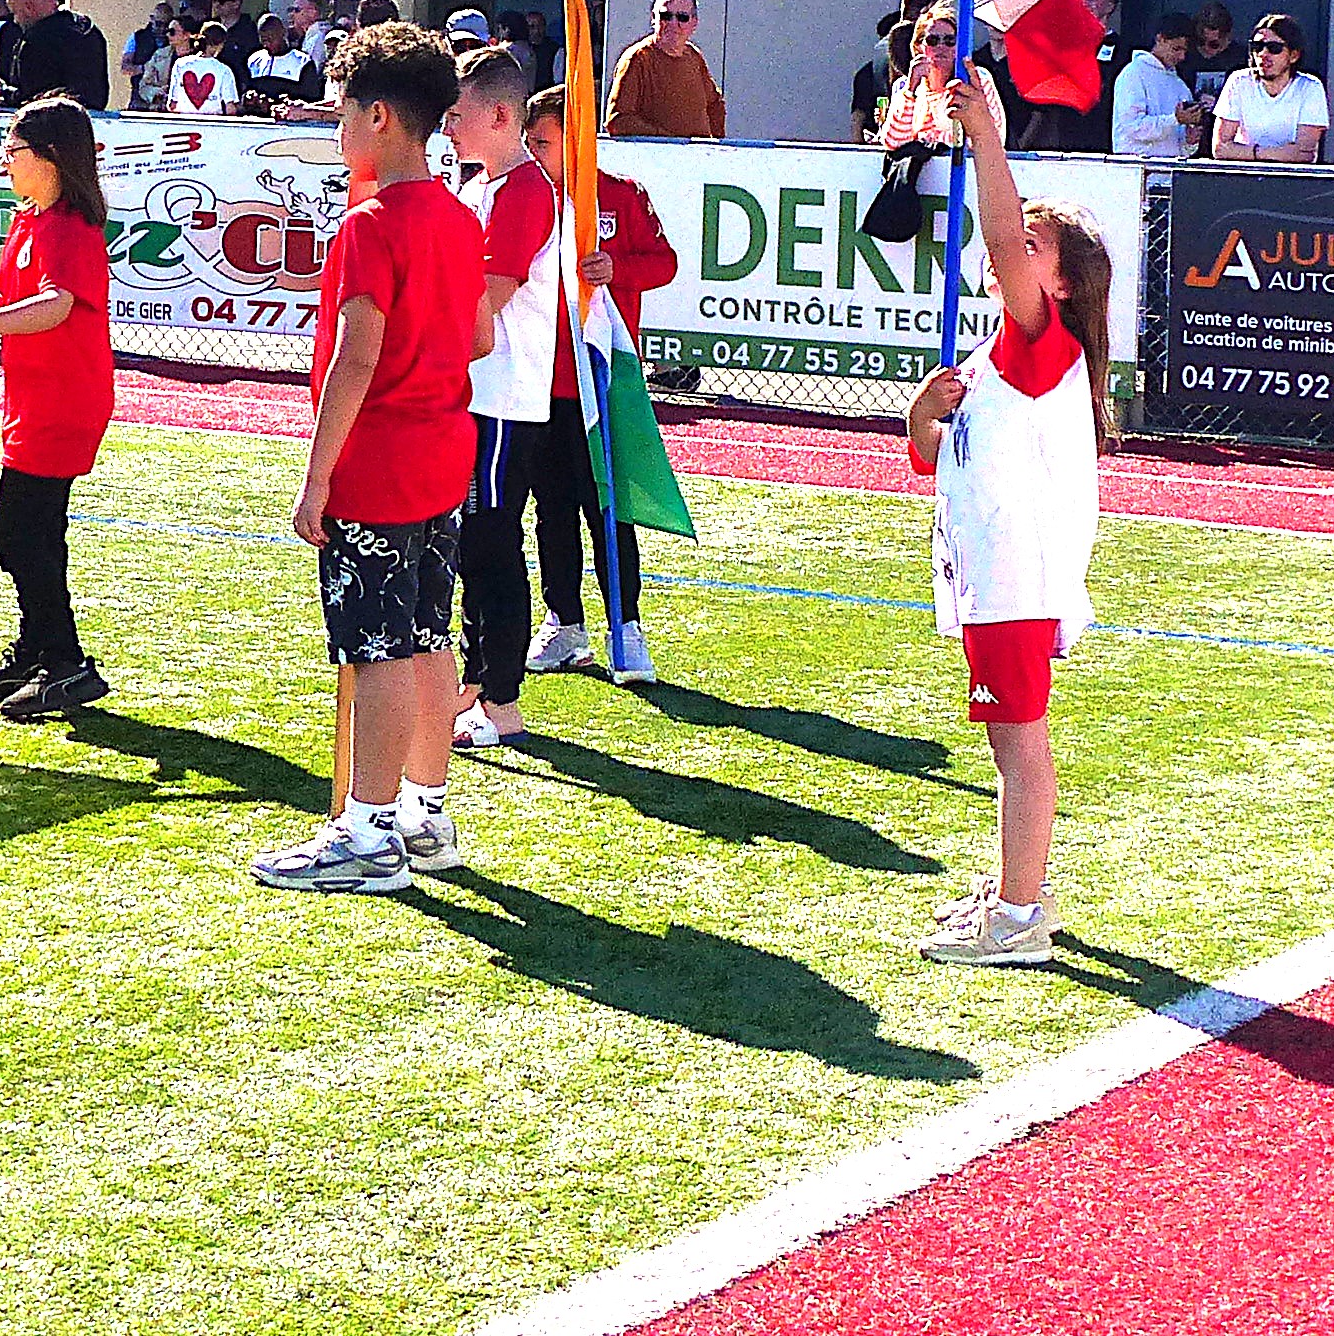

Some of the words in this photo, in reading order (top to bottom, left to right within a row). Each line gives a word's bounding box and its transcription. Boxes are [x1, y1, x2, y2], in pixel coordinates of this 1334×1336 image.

[700, 182, 991, 299] DEKR
[116, 299, 136, 318] DE
[139, 302, 172, 321] GIER
[191, 296, 237, 324] 04
[247, 299, 287, 327] 77
[296, 303, 321, 329] 7
[698, 295, 864, 329] CONTRÔLE
[1182, 310, 1232, 328] Vente
[1236, 313, 1259, 330] de
[1263, 315, 1333, 334] voitures
[1182, 329, 1257, 349] Location
[1261, 333, 1284, 350] de
[712, 340, 750, 367] 04
[760, 343, 796, 370] 77
[805, 346, 839, 373] 55
[849, 350, 886, 377] 29
[896, 353, 925, 380] 31
[1181, 364, 1216, 391] 04
[1221, 366, 1254, 393] 77
[1258, 369, 1291, 396] 75
[1297, 372, 1330, 400] 92
